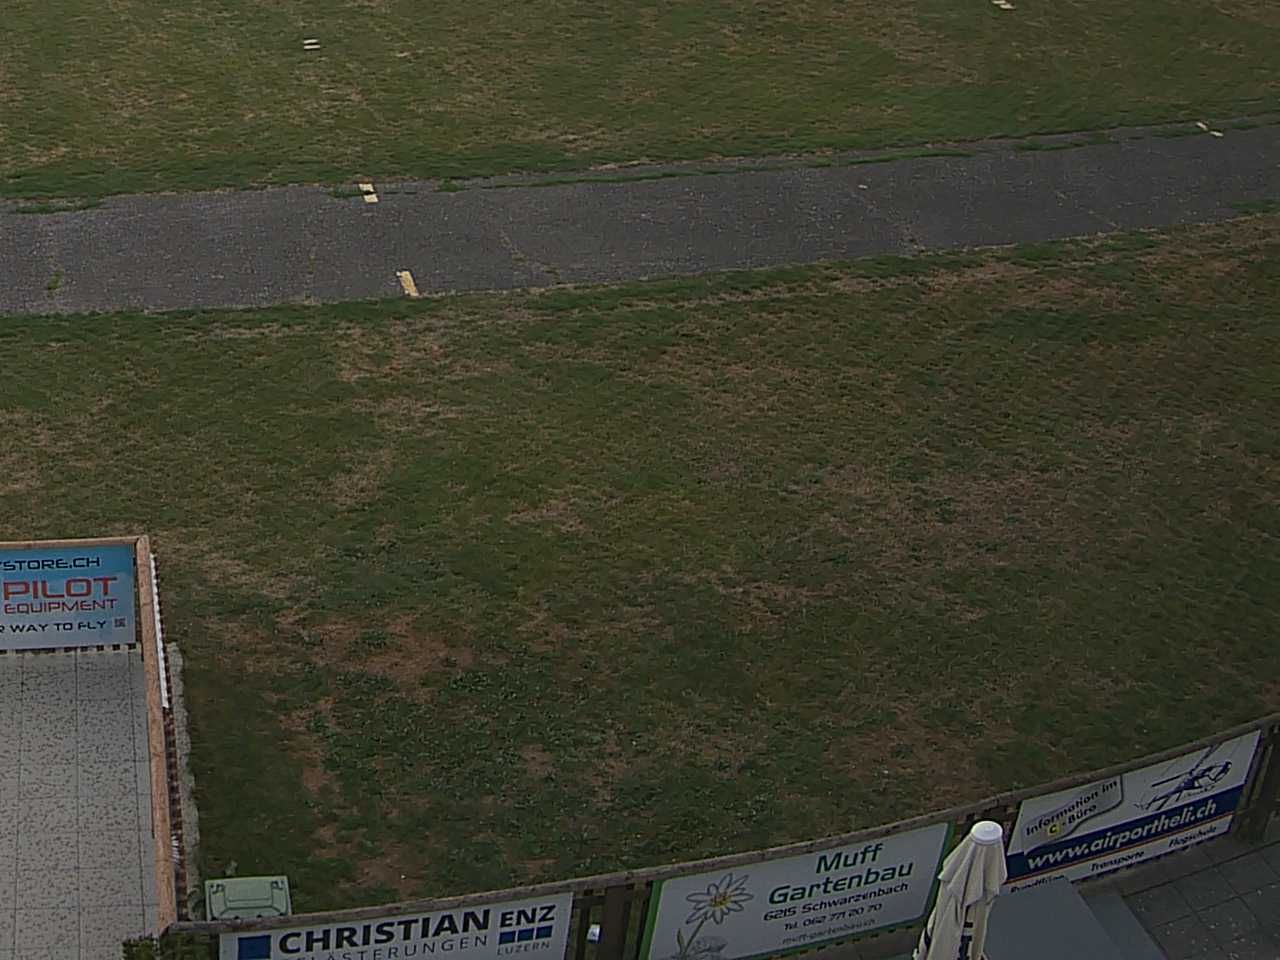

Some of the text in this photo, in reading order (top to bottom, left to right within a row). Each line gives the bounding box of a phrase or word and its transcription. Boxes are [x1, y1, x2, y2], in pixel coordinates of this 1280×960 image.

[2, 576, 118, 601] PILOT
[4, 599, 118, 615] EQUIPMENT
[10, 622, 50, 633] WAY
[54, 621, 73, 632] TO
[77, 619, 107, 631] FLY
[1025, 779, 1118, 837] Information im
[1027, 798, 1216, 870] www.airportheli.ch
[815, 843, 883, 874] Muff
[768, 861, 913, 905] Gartenbau
[763, 882, 909, 922] 6215 Schwarzenbach
[279, 903, 558, 956] CHRISTIAN ENZ
[289, 935, 488, 960] ÄSTERUNGEN
[496, 941, 552, 957] LUZERN
